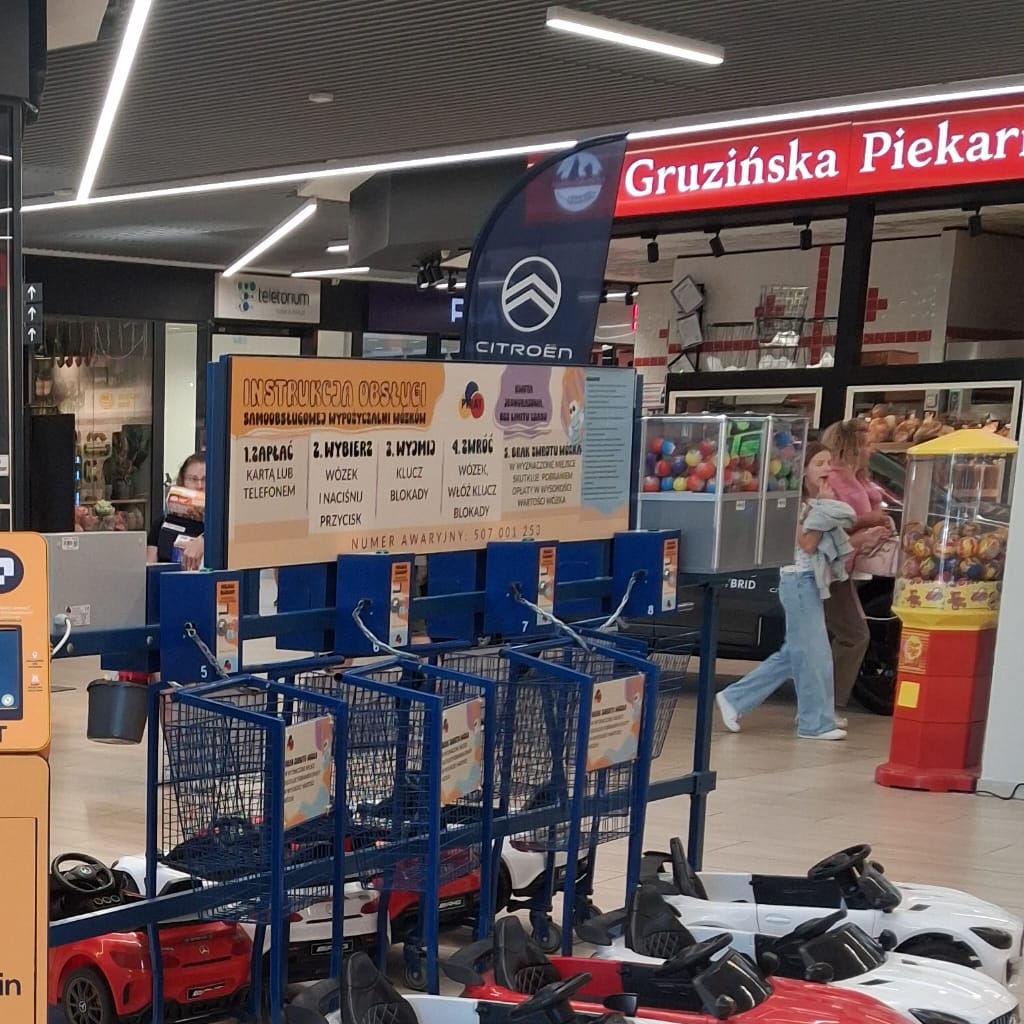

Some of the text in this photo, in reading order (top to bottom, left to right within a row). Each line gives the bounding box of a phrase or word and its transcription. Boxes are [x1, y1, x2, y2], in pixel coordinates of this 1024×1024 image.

[624, 120, 1024, 197] Gruzińska Piekar
[476, 341, 573, 360] CITROËN
[243, 378, 426, 408] INSTRUKCJA OBSŁUGI
[243, 411, 326, 426] SAMOOBSŁUGOWEJ
[313, 441, 373, 459] 2. WYBIERZ
[386, 440, 436, 457] 3. WYJMIJ
[451, 434, 494, 455] 4. ZWRÓĆ
[246, 467, 294, 482] KARTĄ LUB
[325, 466, 358, 480] WÓZEK
[396, 466, 424, 479] KLUCZ
[243, 485, 296, 499] TELEFONEM
[323, 489, 363, 504] NACIŚNIJ
[390, 487, 429, 501] BLOKADY
[447, 482, 497, 498] WŁÓŻ KLUCZ
[453, 505, 490, 519] BLOKADY
[320, 513, 362, 527] PRZYCISK
[351, 536, 395, 550] NUMER
[474, 527, 493, 541] 507
[498, 526, 517, 539] 001
[522, 524, 541, 537] 253
[647, 604, 654, 615] 8
[521, 621, 529, 633] 7
[200, 665, 208, 679] 5
